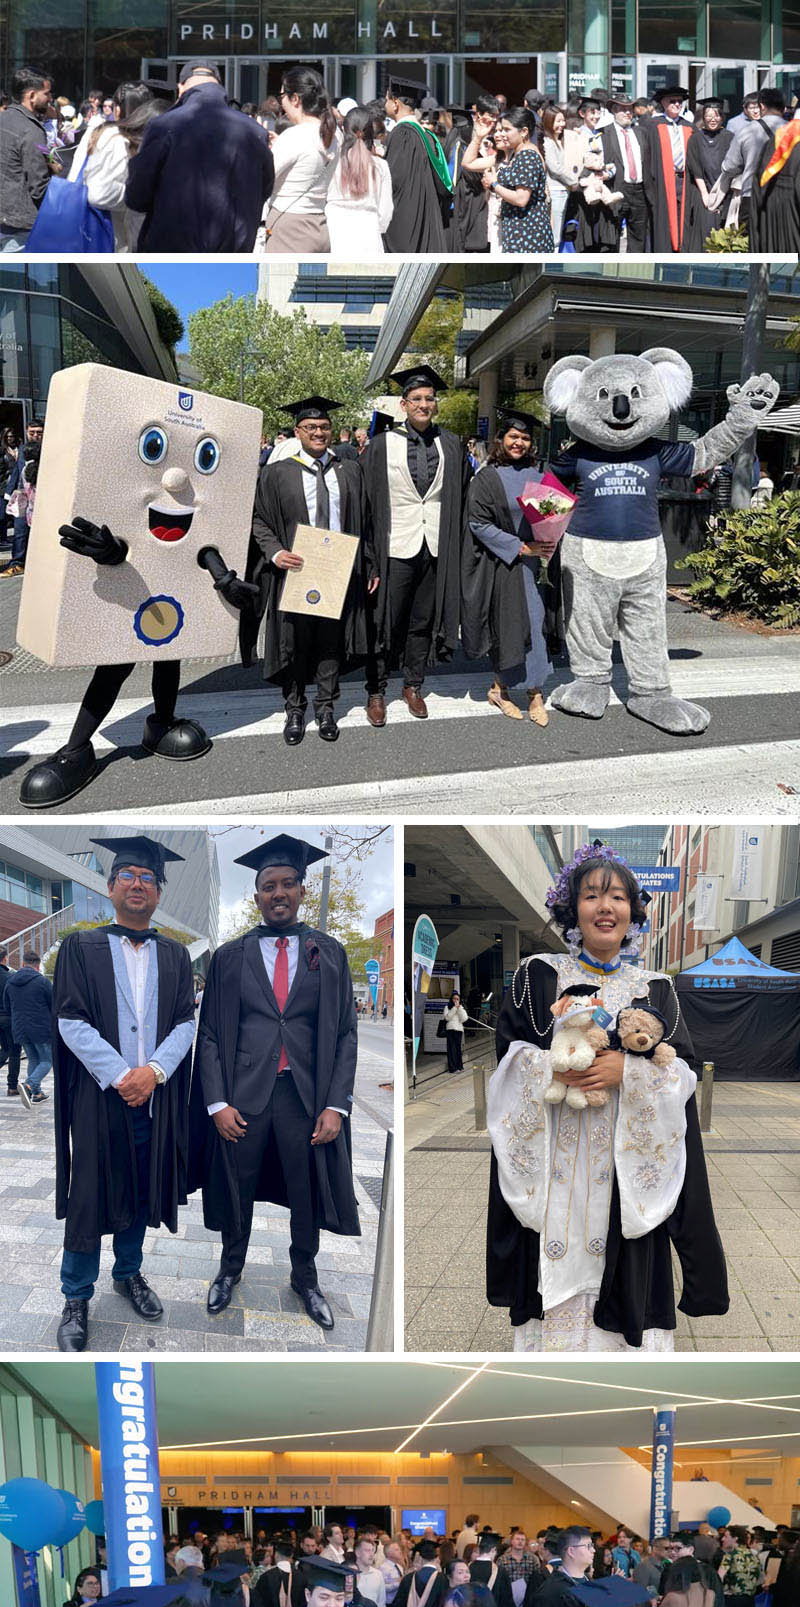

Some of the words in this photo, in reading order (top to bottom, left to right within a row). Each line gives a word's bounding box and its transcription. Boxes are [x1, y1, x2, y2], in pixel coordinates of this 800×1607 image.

[181, 22, 328, 40] PRIDHAM
[358, 20, 442, 38] HALL
[588, 463, 650, 480] UNIVERSITY
[604, 477, 637, 486] SOUTH
[594, 485, 646, 497] AUSTRALIA
[693, 977, 737, 989] USASA
[112, 1362, 157, 1588] ngratulation
[199, 1491, 279, 1500] PRIDHAM
[290, 1490, 331, 1500] HALL
[653, 1444, 668, 1539] Congratulatio
